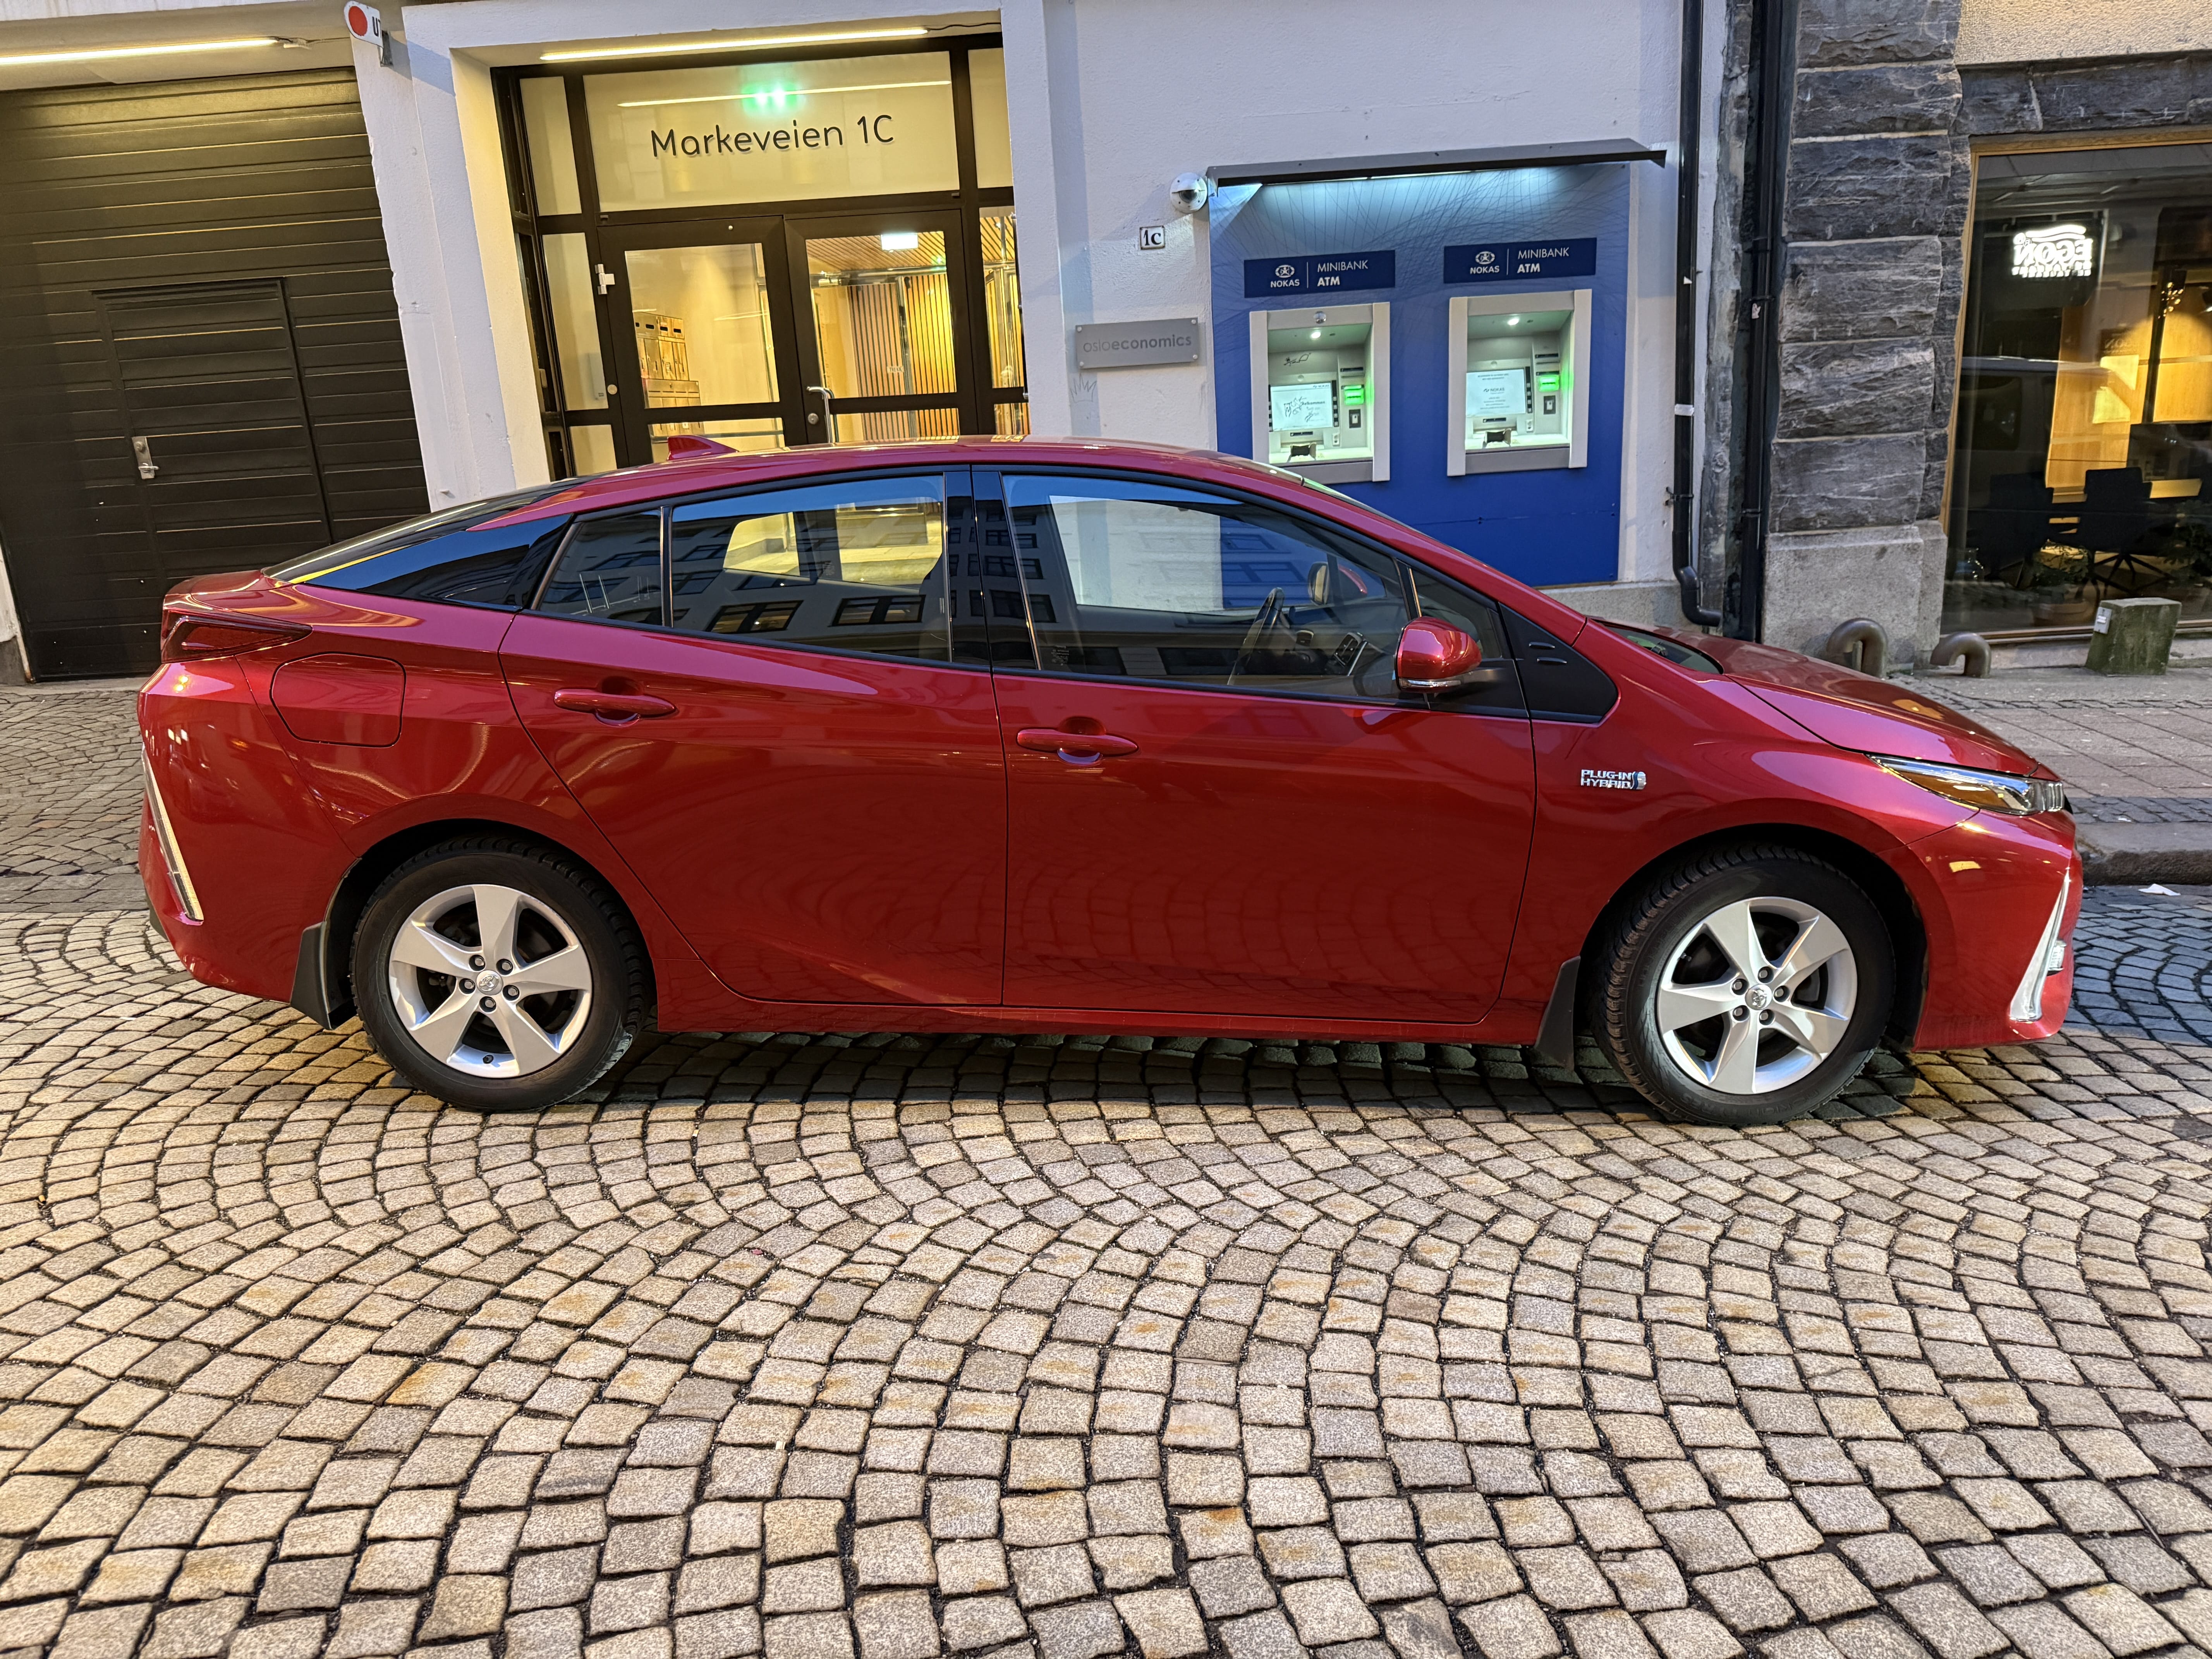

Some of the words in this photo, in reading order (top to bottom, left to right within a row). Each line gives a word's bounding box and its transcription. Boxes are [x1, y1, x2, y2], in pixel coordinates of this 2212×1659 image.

[651, 120, 843, 158] Markeveien
[857, 114, 894, 144] 1C
[1143, 229, 1162, 246] 1c
[1518, 247, 1570, 259] MINIBANK
[1317, 259, 1369, 273] MINIBANK
[1470, 265, 1500, 274] NOKAS
[1517, 263, 1540, 273] ATM
[1270, 279, 1300, 288] NOKAS
[1317, 276, 1340, 287] ATM
[1083, 334, 1192, 352] osloeconomics
[1581, 769, 1632, 780] PLUG-IN
[1580, 777, 1632, 789] HYBRID
